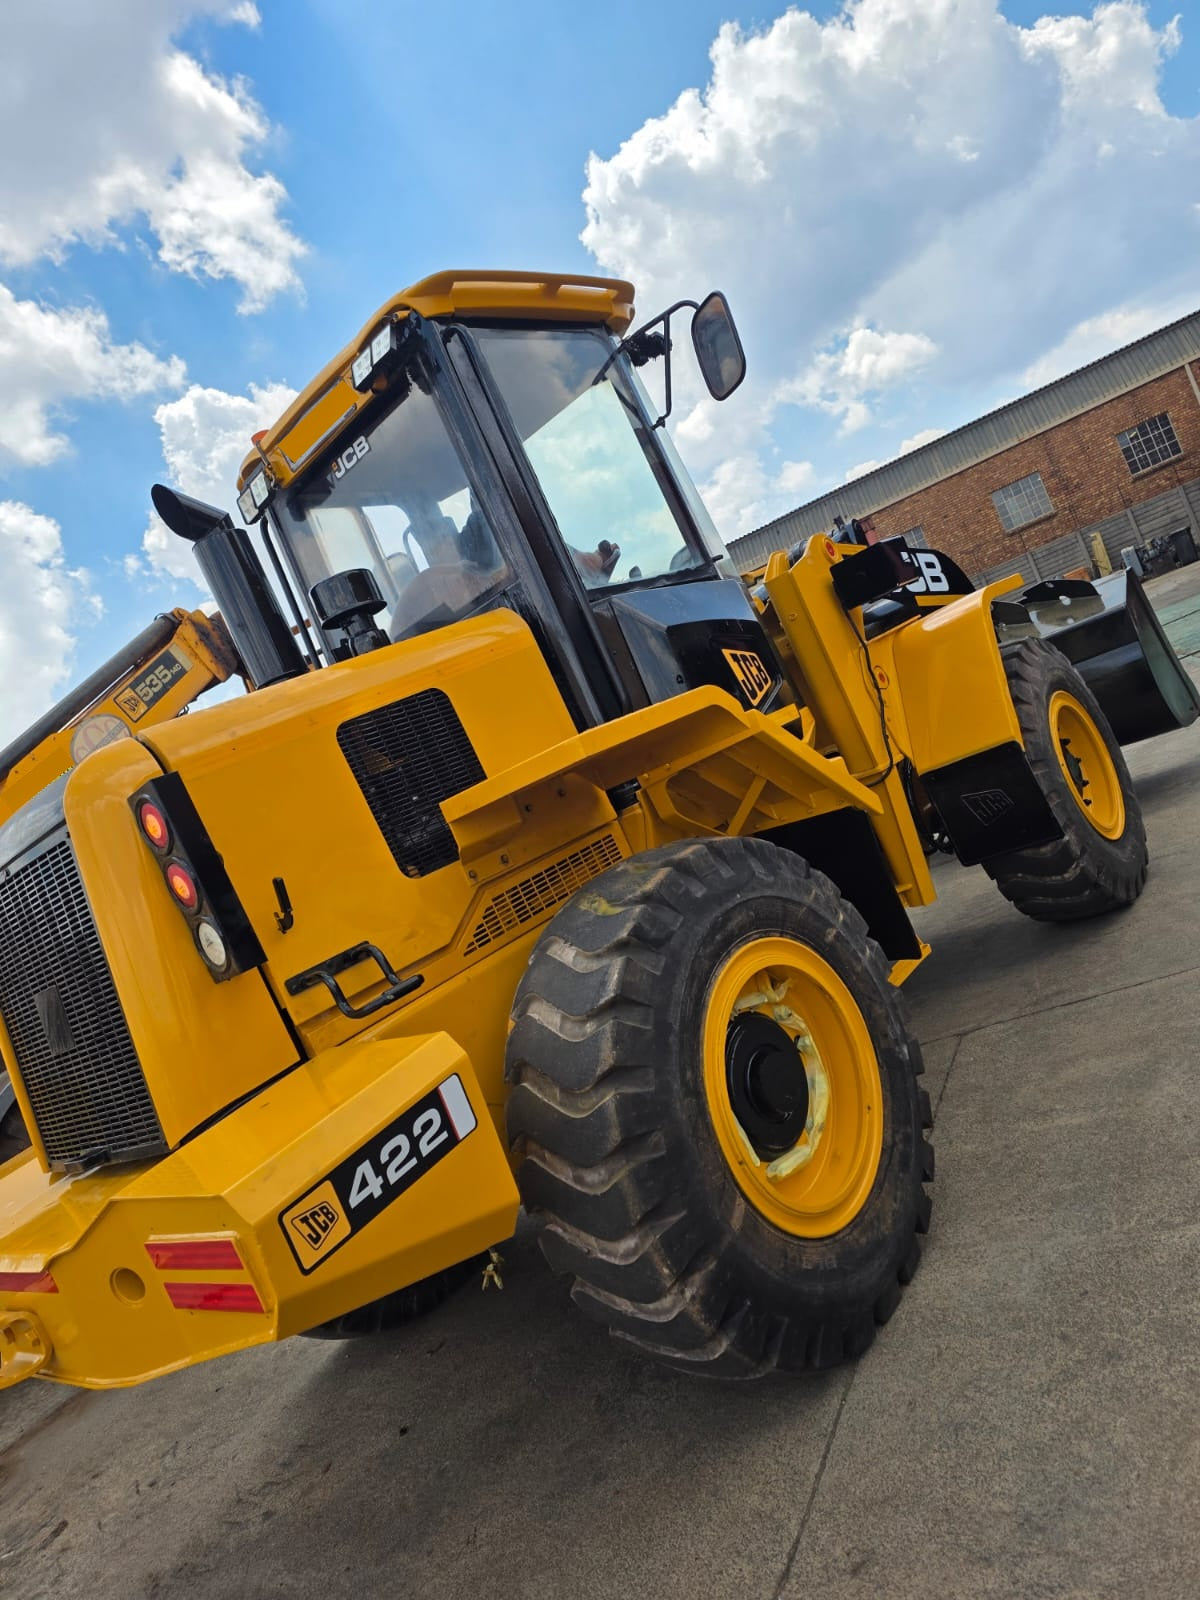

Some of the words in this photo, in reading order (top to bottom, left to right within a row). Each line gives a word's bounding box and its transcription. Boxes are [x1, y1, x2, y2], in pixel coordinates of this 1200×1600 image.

[335, 435, 370, 479] JCB
[134, 664, 172, 701] 535
[729, 653, 769, 700] JCB
[299, 1205, 336, 1245] JCB
[349, 1107, 449, 1209] 422
